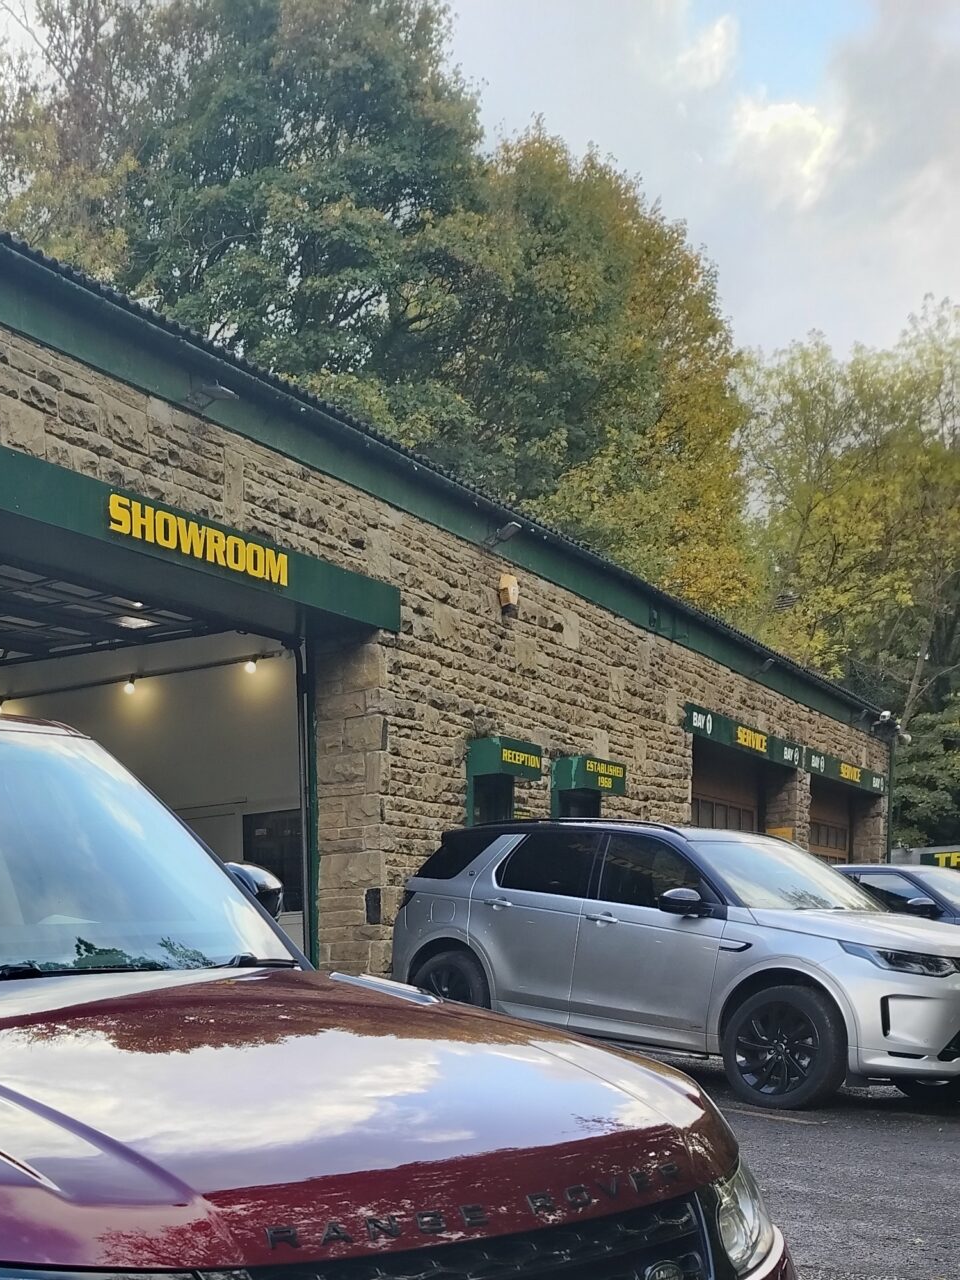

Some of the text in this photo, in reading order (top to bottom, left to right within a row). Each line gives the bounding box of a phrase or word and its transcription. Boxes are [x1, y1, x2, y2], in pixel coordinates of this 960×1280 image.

[109, 492, 288, 587] SHOWROOM
[692, 711, 706, 730] BAY
[736, 725, 768, 753] SERVICE
[502, 748, 541, 769] RECEPTION
[783, 746, 794, 761] BAY
[586, 759, 624, 778] ESTABLISHED
[840, 762, 861, 783] SERVICE
[264, 1203, 490, 1251] RANGE
